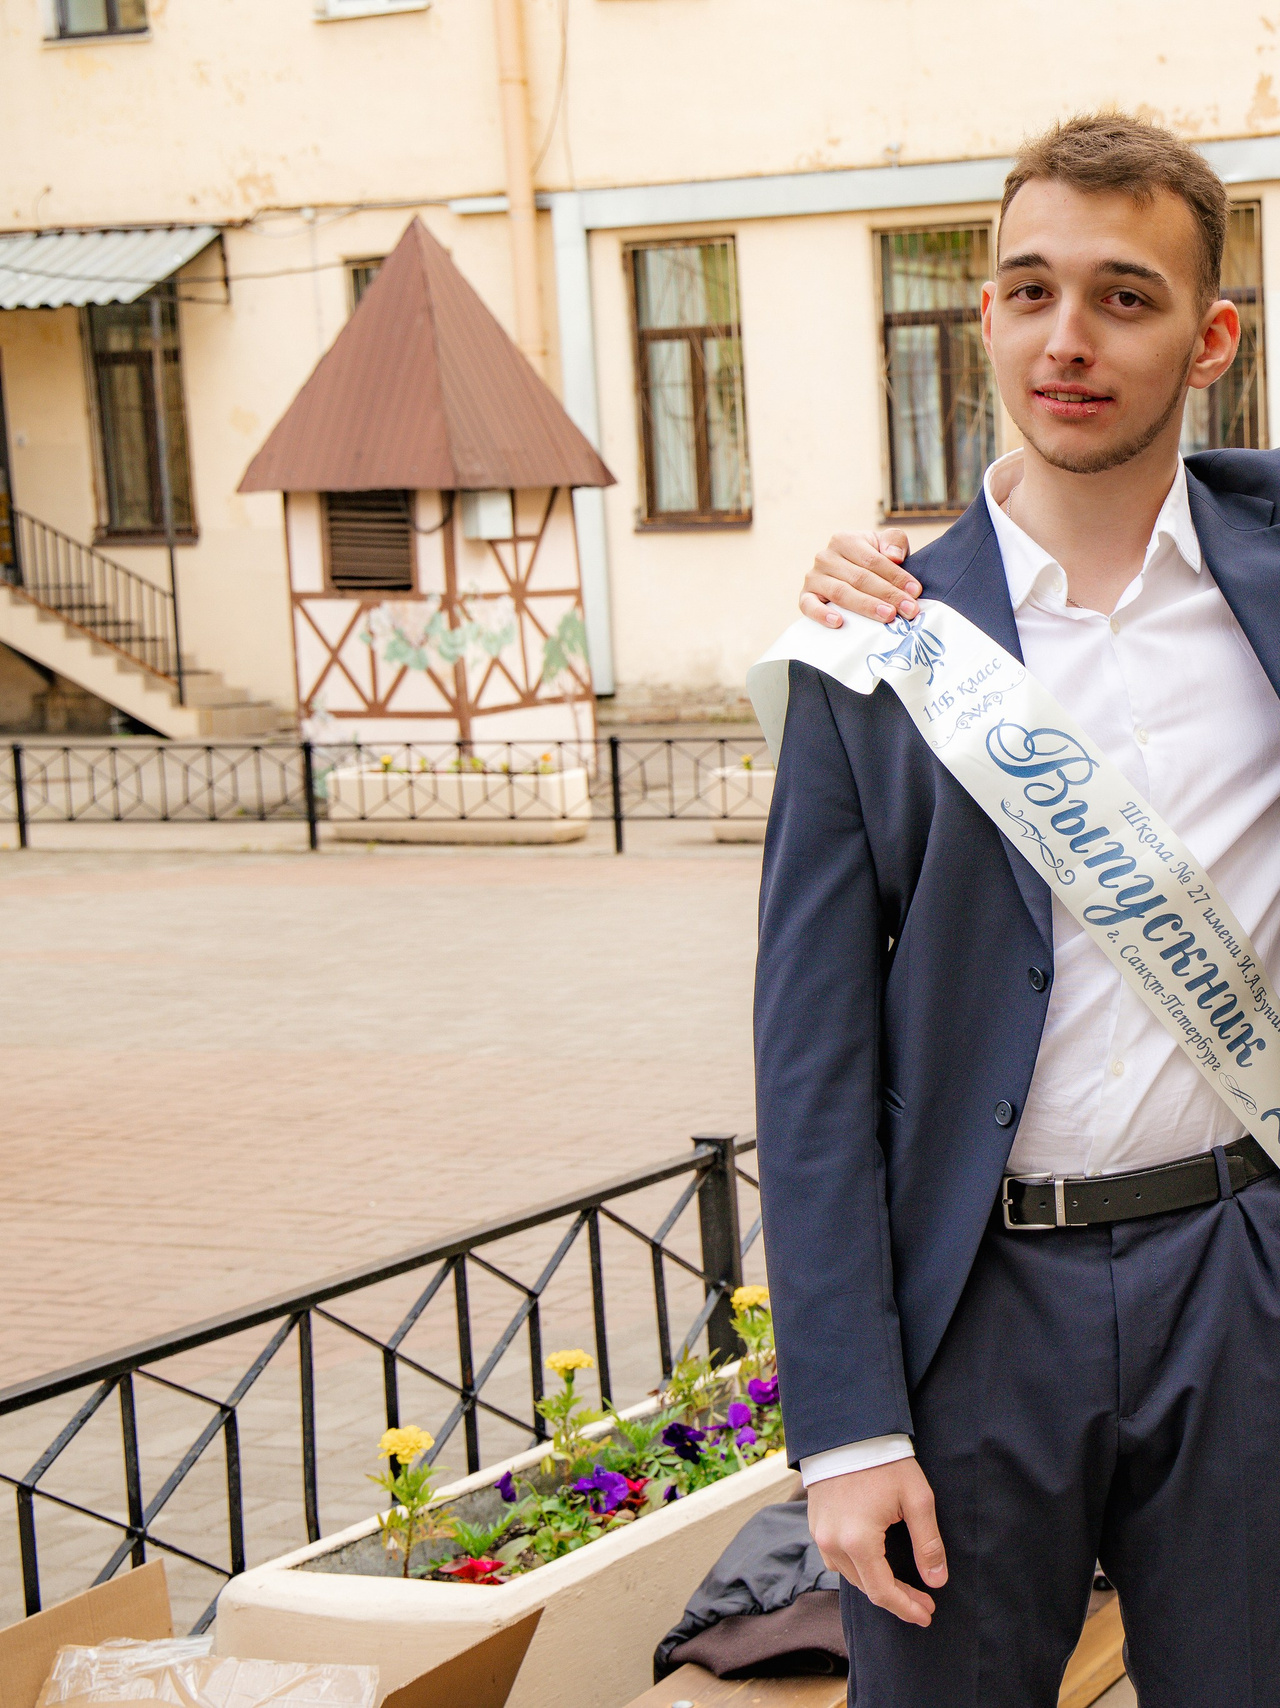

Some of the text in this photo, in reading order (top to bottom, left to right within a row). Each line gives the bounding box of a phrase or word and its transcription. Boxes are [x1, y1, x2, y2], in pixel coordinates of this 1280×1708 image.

[923, 658, 1001, 723] 11Б класс
[986, 718, 1266, 1068] Выпускник
[1119, 801, 1175, 863] Школа
[1169, 861, 1191, 886] №
[1187, 884, 1211, 904] 27
[1202, 907, 1242, 958] имени
[1107, 930, 1222, 1072] г. Санкт-Петербург
